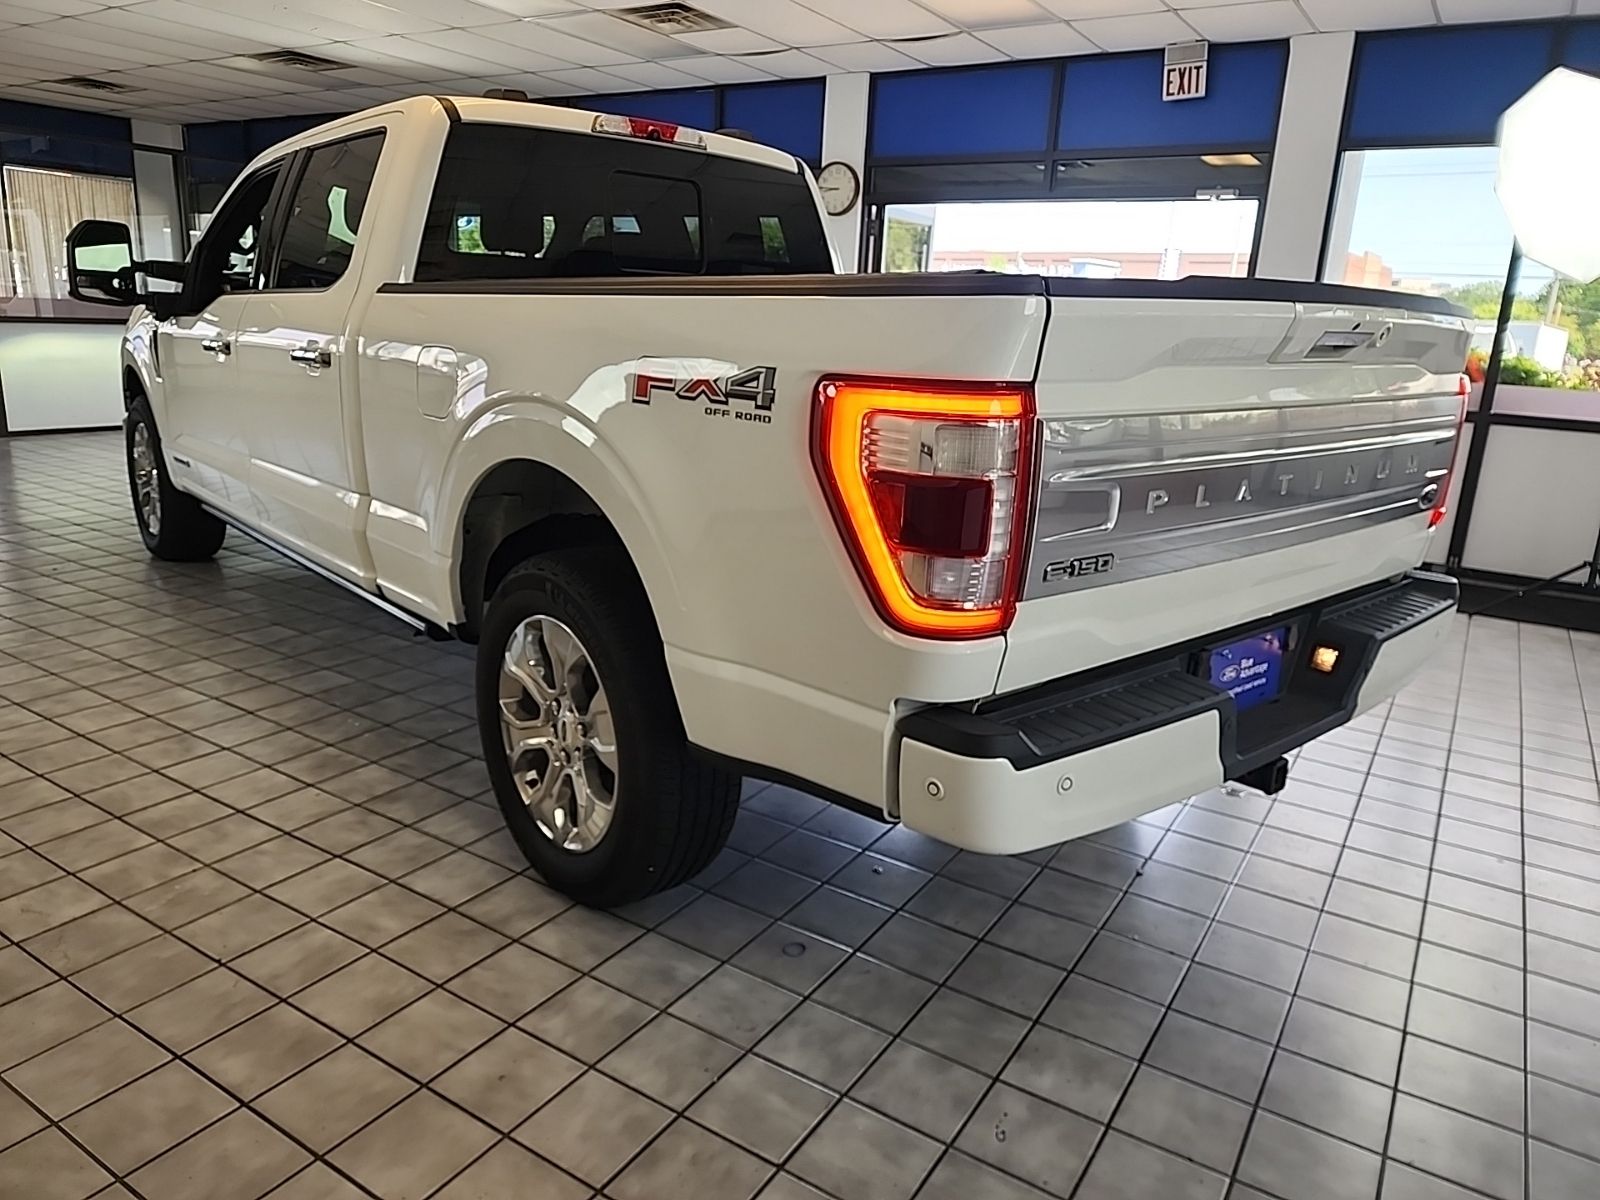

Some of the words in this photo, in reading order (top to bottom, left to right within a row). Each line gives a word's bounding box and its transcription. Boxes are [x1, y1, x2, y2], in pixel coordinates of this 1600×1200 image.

[1166, 65, 1203, 96] EXIT
[632, 355, 777, 411] FX4
[704, 407, 731, 418] OFF
[735, 411, 772, 424] ROAD
[1146, 455, 1419, 515] PLATINUM
[1042, 552, 1115, 582] F-150
